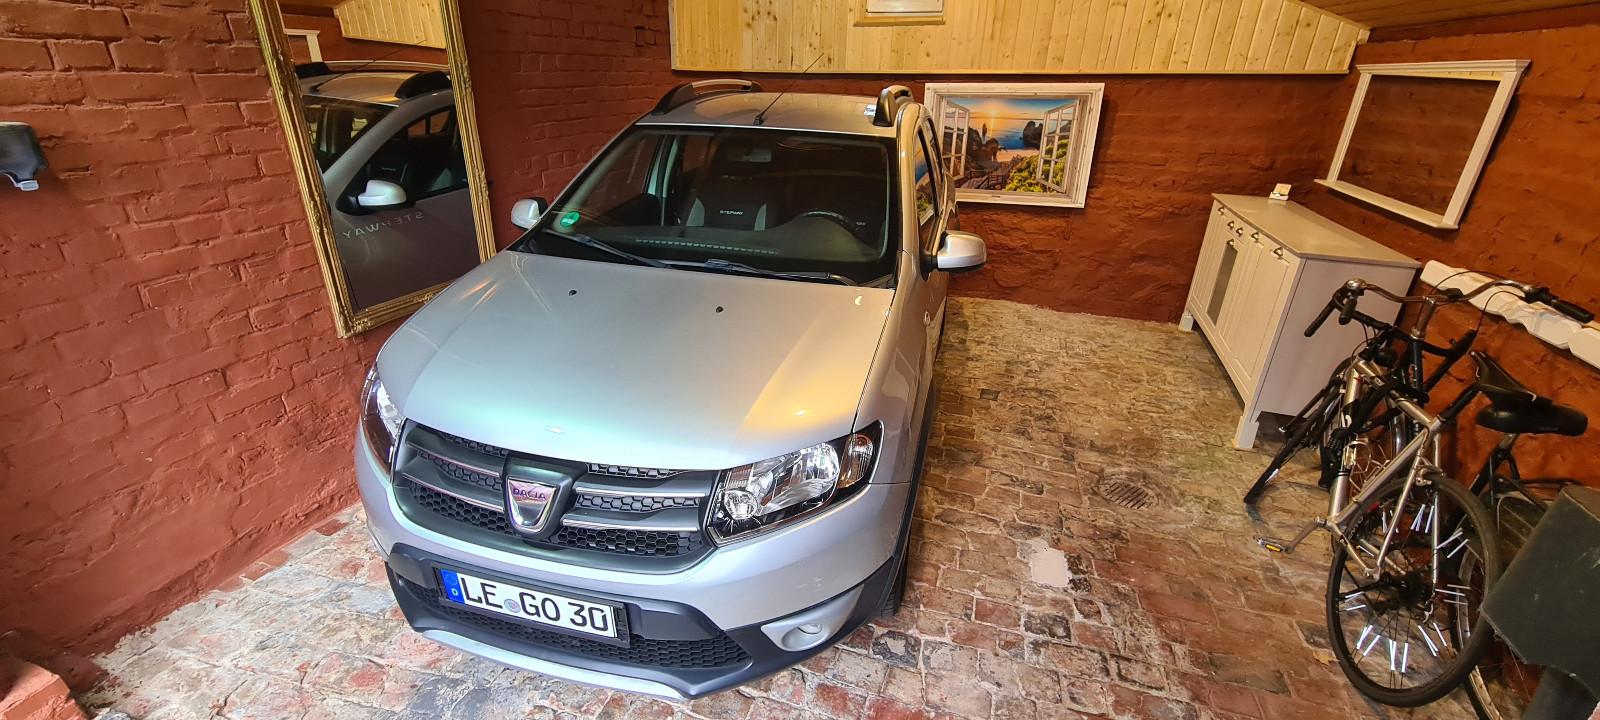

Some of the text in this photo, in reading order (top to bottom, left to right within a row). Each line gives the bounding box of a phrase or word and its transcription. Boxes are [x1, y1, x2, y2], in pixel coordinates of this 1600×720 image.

[513, 487, 546, 499] DACIA
[460, 577, 609, 632] LE GO 30
